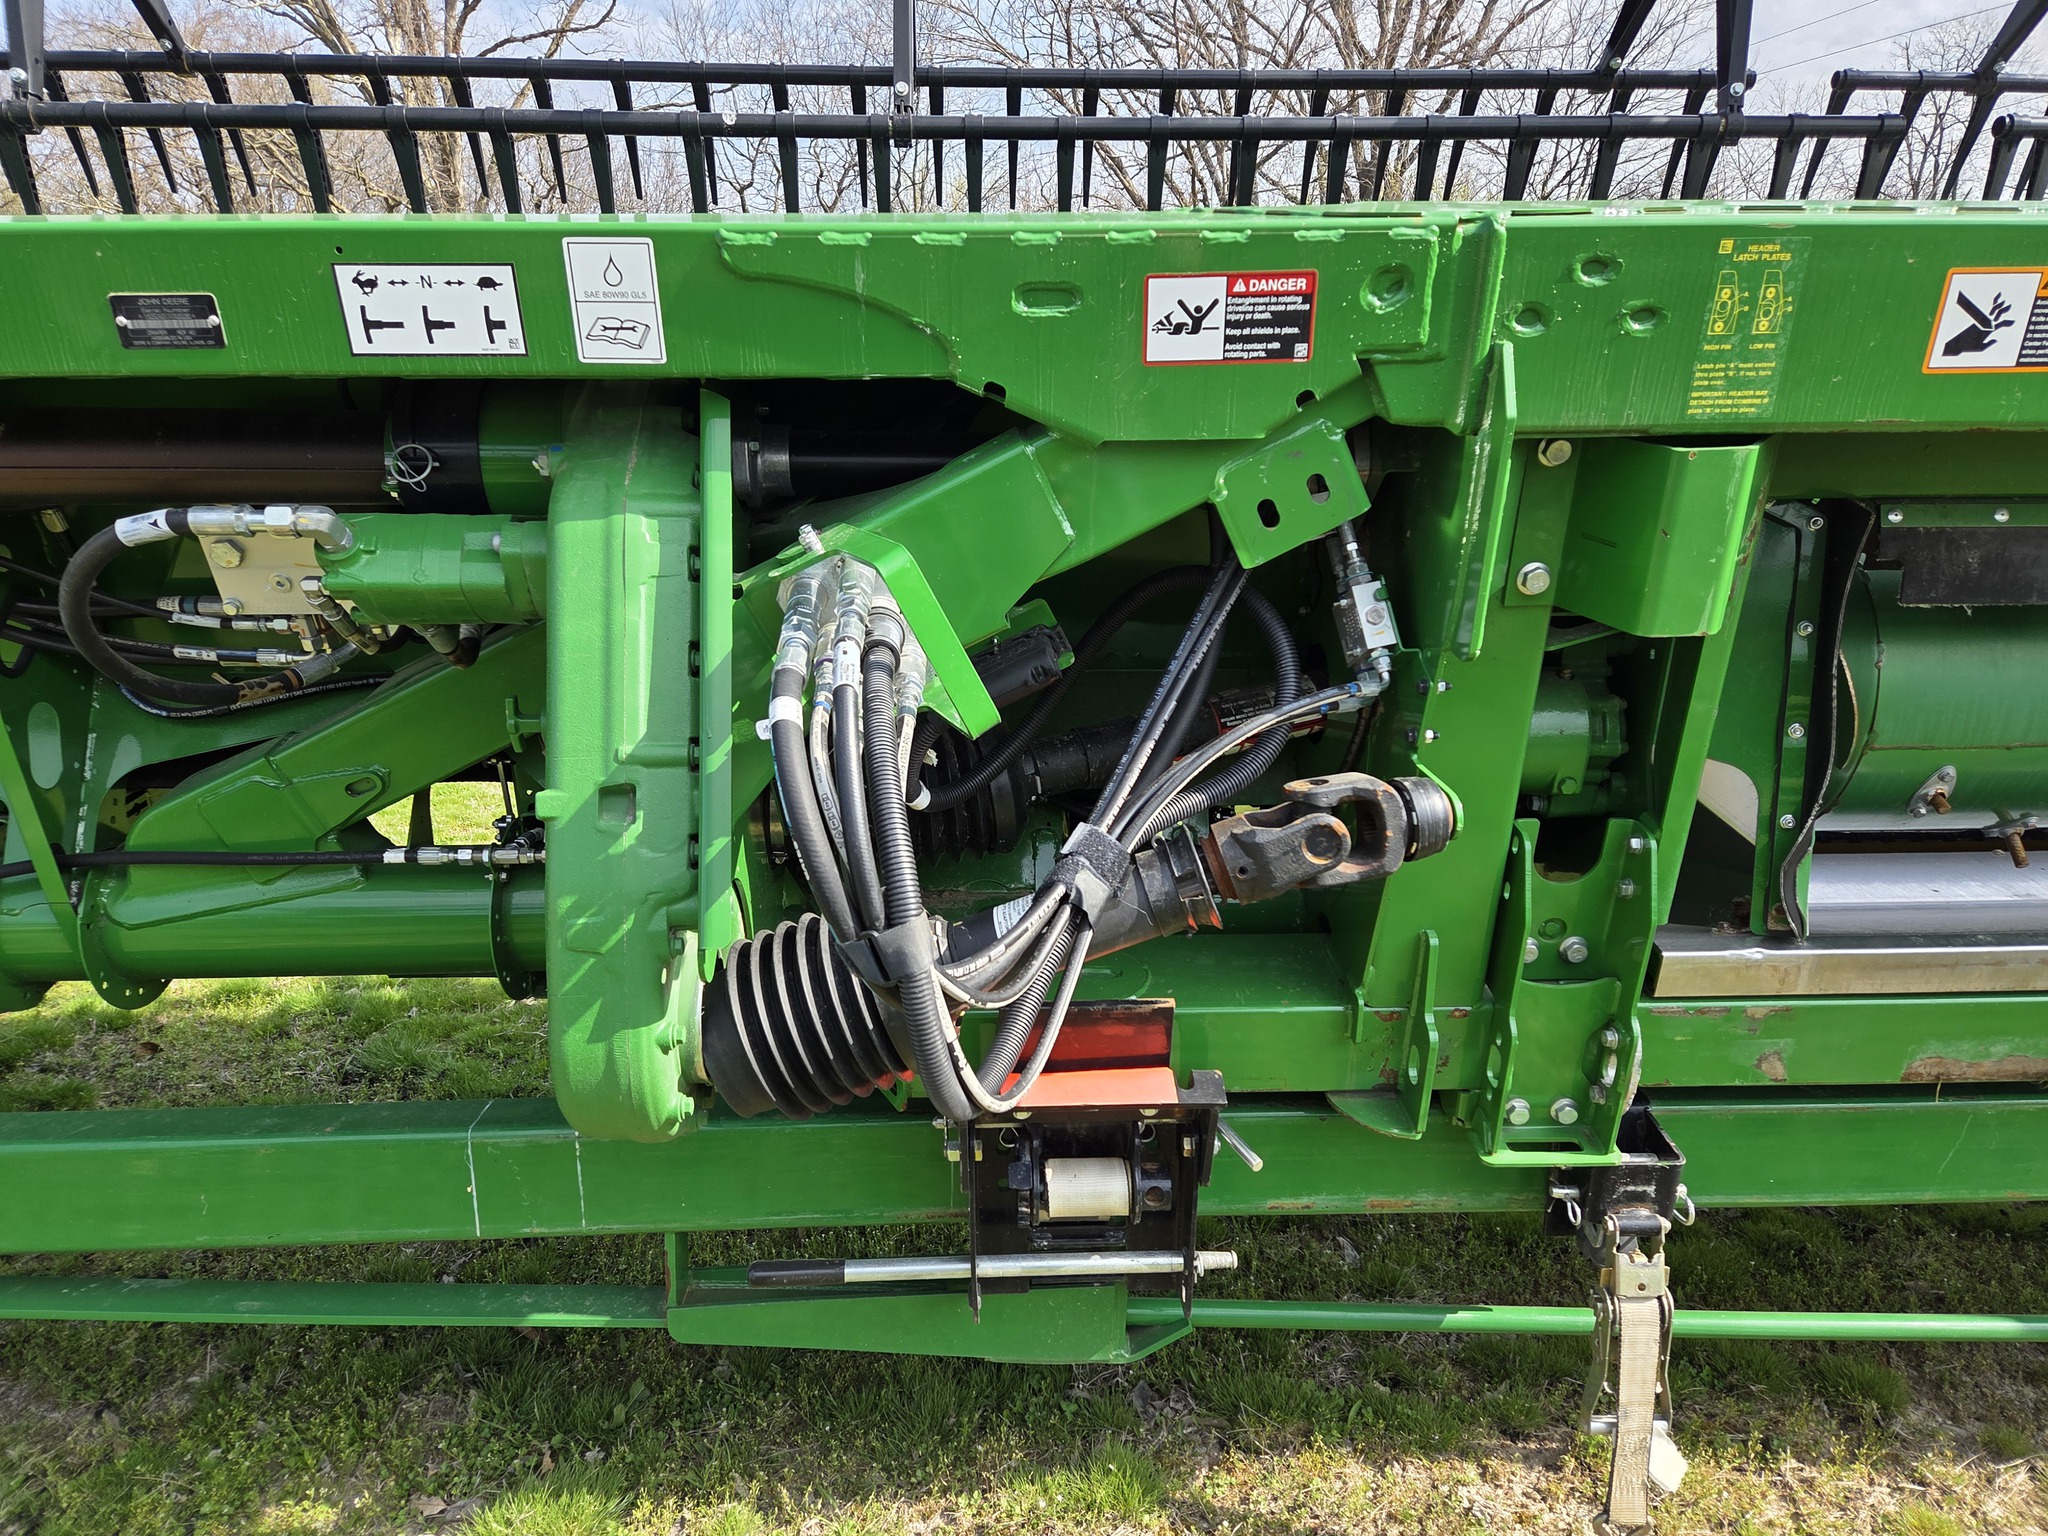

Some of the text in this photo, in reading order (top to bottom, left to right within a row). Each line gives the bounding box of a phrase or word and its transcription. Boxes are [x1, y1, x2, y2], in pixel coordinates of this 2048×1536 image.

[1249, 278, 1306, 292] DANGER
[602, 291, 629, 299] 80W90
[630, 291, 647, 299] GL5
[1227, 295, 1302, 305] Entanglement in rotating
[1226, 304, 1253, 312] driveline
[1226, 313, 1244, 321] injury
[1226, 326, 1300, 336] Keep all shields in place.
[1225, 342, 1242, 350] Avoid
[1243, 342, 1266, 350] contact
[1224, 351, 1248, 359] rotating
[1173, 629, 1192, 657] exceeds
